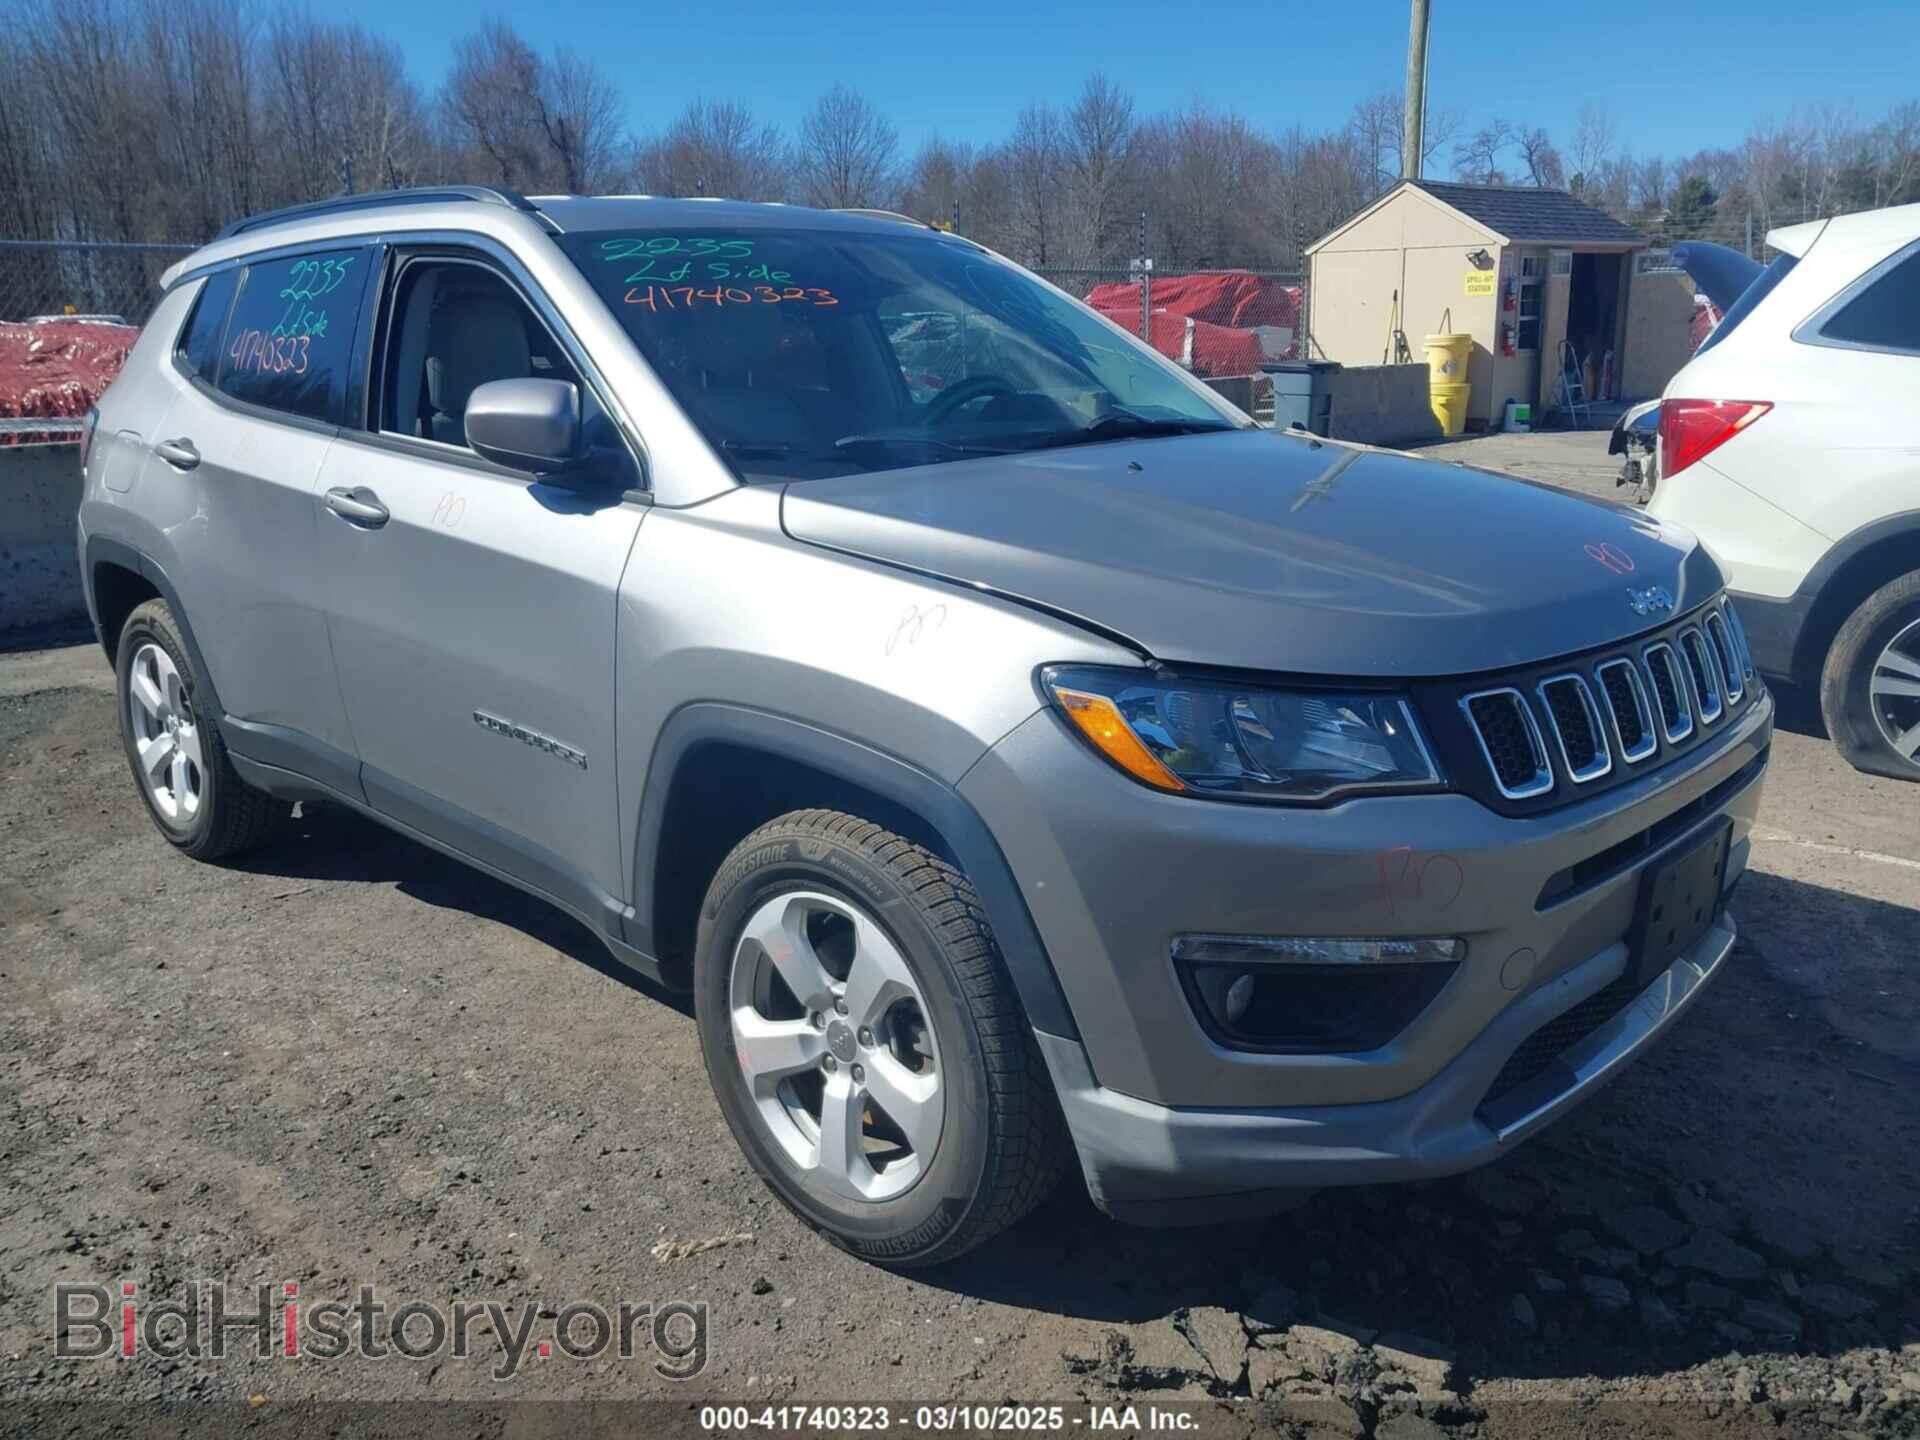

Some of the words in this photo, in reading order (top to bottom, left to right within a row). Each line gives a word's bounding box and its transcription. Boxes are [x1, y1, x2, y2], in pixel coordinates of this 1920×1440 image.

[601, 238, 755, 260] 2235
[280, 256, 356, 301] 2235
[707, 263, 795, 284] Side
[624, 285, 839, 312] 41740323
[230, 328, 311, 375] 41740323
